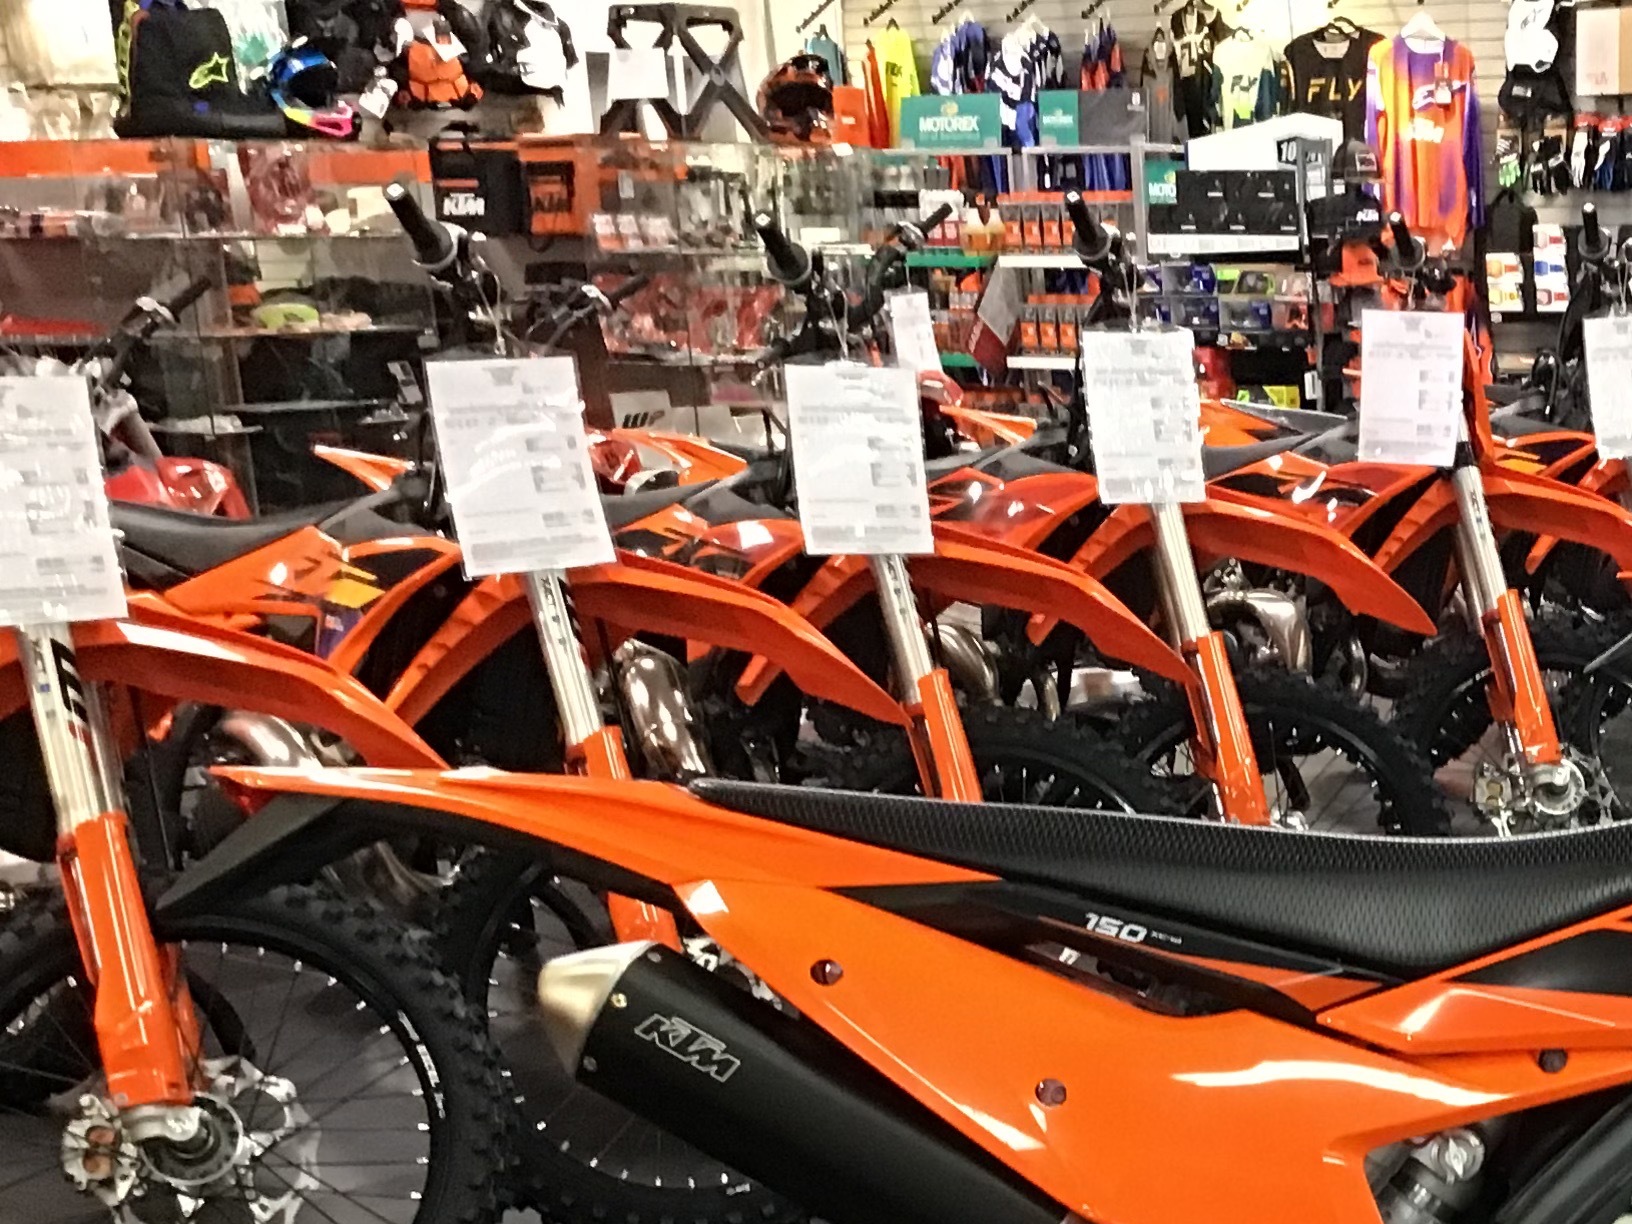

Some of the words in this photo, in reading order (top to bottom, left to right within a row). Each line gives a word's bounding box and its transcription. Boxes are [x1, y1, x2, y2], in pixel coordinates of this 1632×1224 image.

[1308, 78, 1363, 102] FLY
[918, 114, 980, 132] MOTOREX
[443, 193, 485, 216] KTM
[1085, 911, 1148, 943] 150
[634, 1013, 741, 1083] KTM
